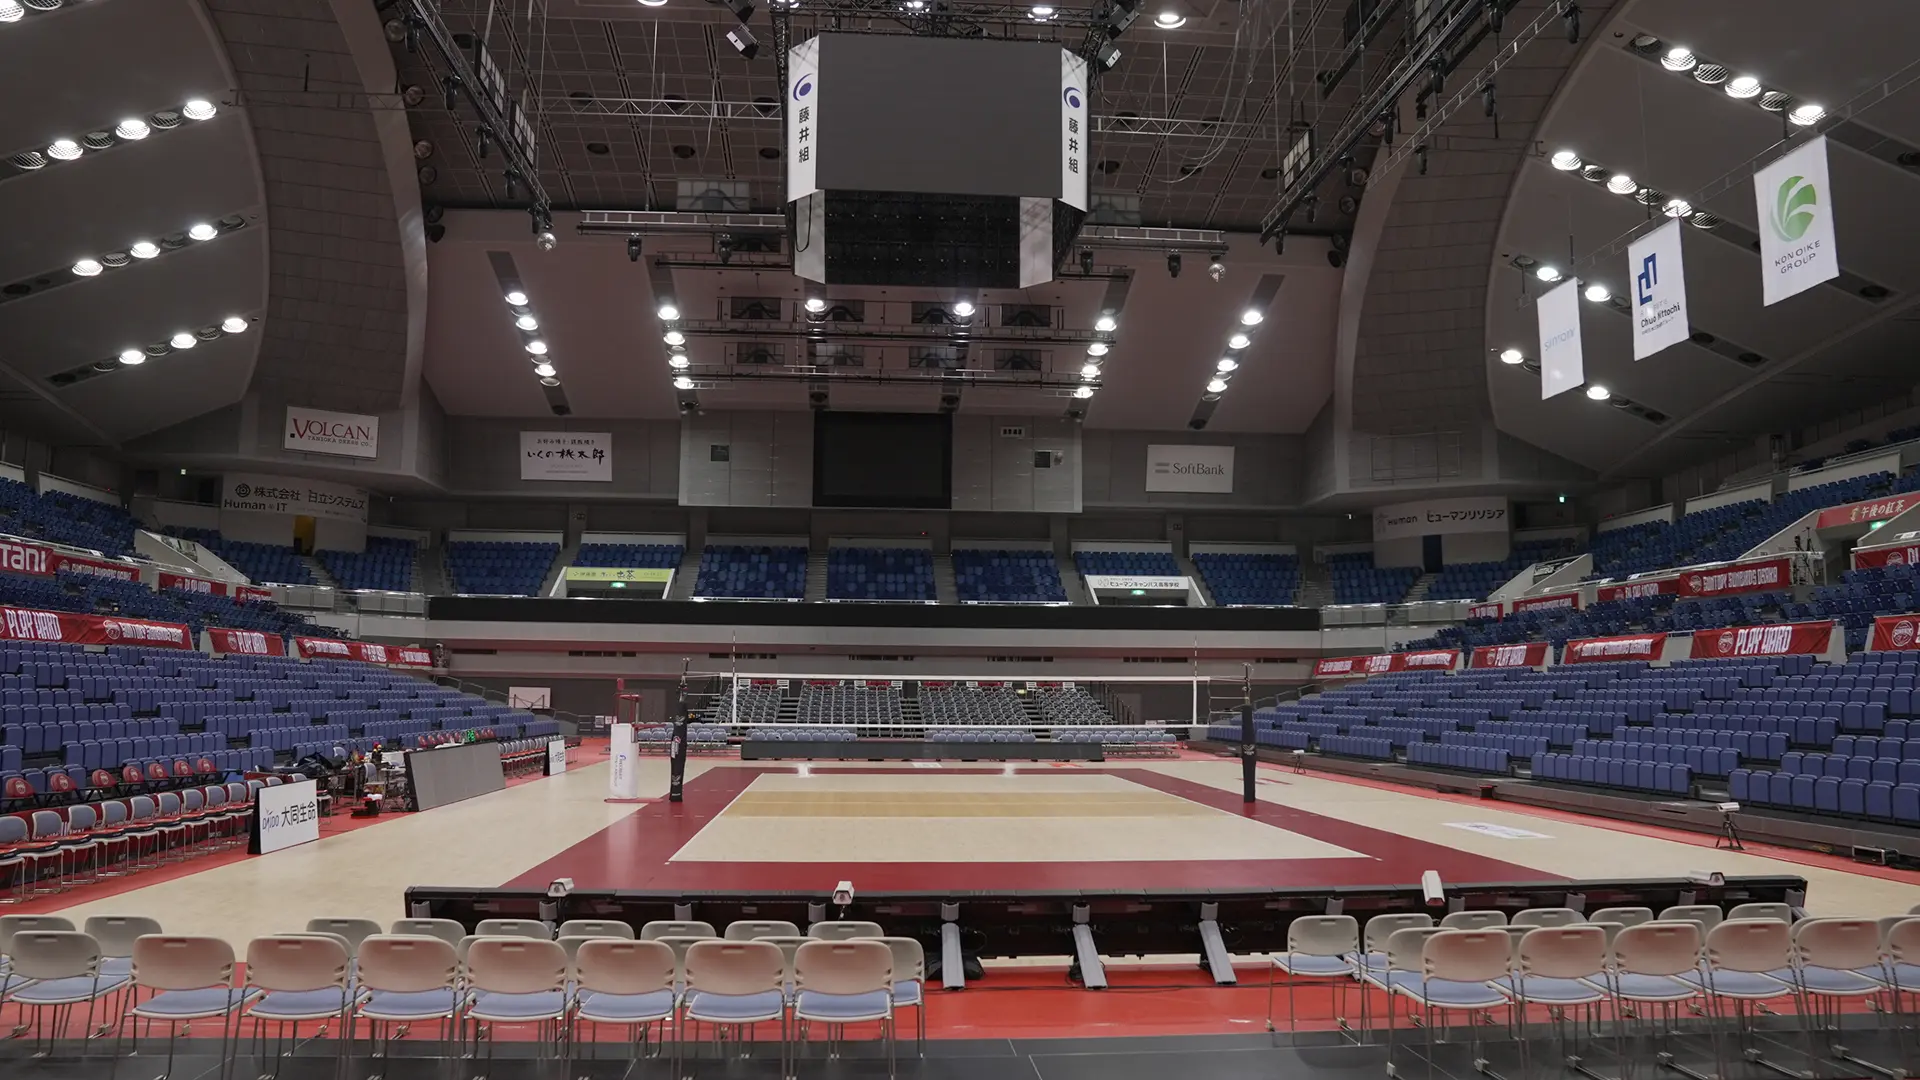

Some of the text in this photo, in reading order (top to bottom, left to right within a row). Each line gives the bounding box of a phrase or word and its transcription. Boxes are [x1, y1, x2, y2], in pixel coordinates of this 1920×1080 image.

[799, 105, 810, 164] 藤井組
[1068, 116, 1079, 174] 藤井組
[1774, 239, 1821, 267] KONOIKE
[1780, 252, 1816, 274] GROUP
[1640, 315, 1657, 328] Chuo
[292, 417, 371, 441] VOLCAN
[527, 447, 605, 465] いくの桃太郎
[1172, 462, 1225, 475] SoftBank
[223, 498, 288, 512] Human IT
[253, 485, 365, 510] 株式会社 日立システムズ
[1861, 499, 1905, 519] 午後の紅茶
[1426, 509, 1505, 523] ヒューマンリソシア
[5, 609, 63, 641] PLAY HARD
[1734, 625, 1793, 655] PLAY HARD
[281, 801, 316, 827] 大同生命
